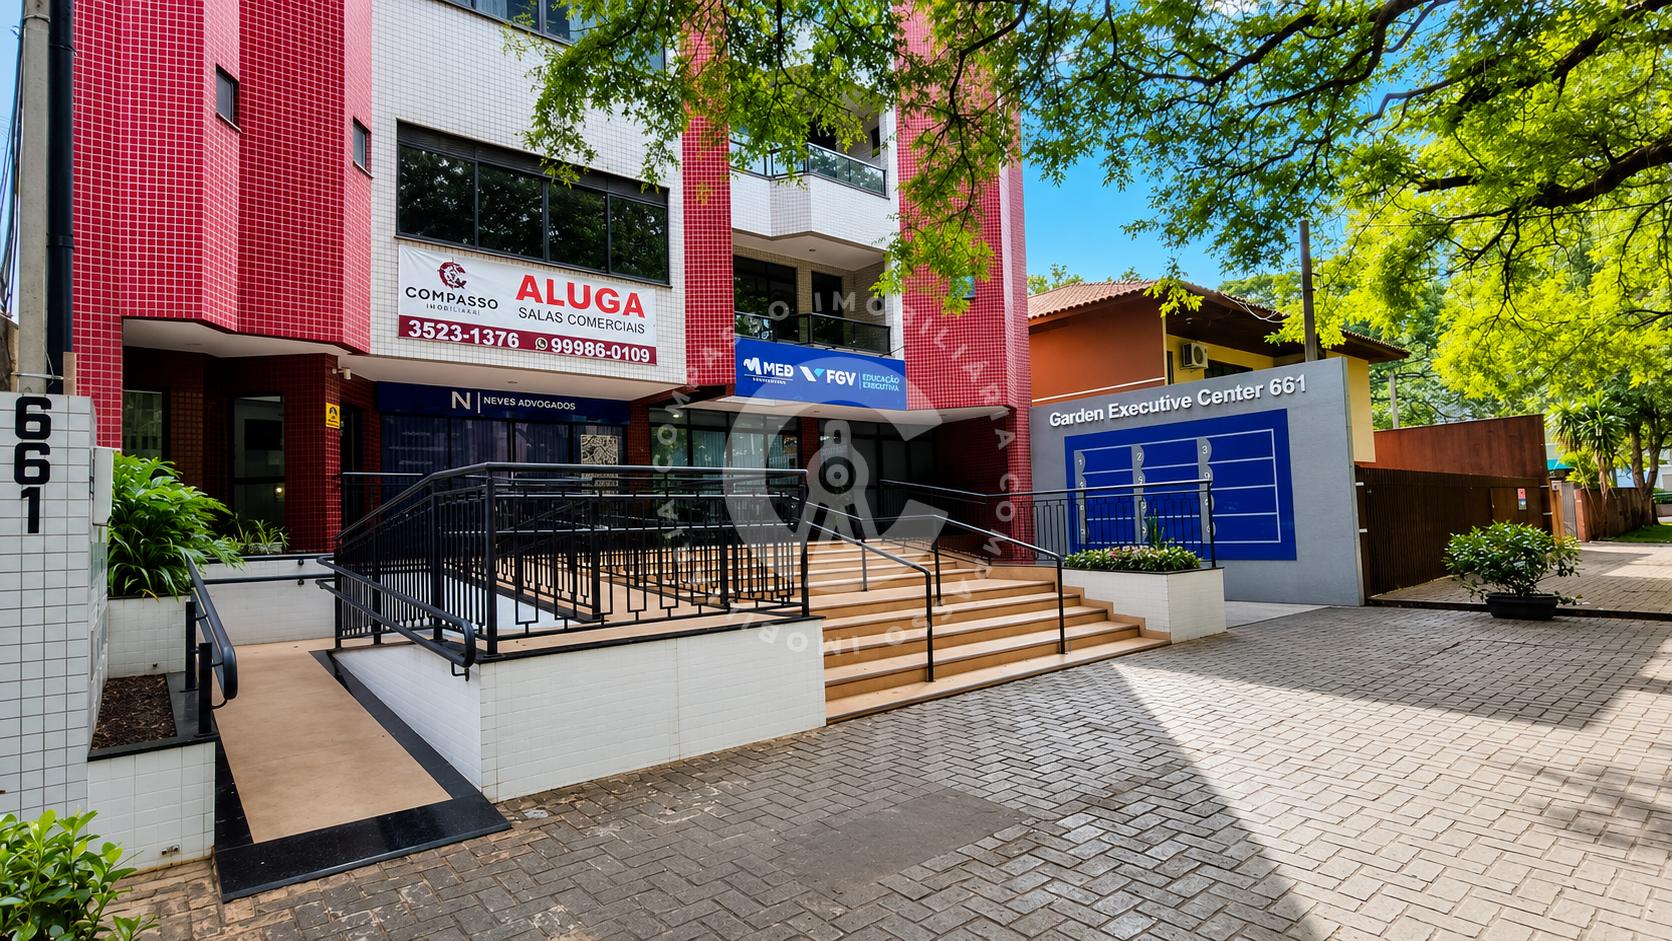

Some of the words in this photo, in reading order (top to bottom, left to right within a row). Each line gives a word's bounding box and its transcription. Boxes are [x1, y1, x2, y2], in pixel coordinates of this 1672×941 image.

[405, 286, 499, 310] COMPASSO
[516, 274, 645, 318] ALUGA
[408, 319, 519, 348] 3523-1376
[518, 307, 563, 323] SALAS
[567, 313, 645, 334] COMERCIAIS
[550, 337, 650, 362] 99986-0109
[826, 369, 857, 387] FGV
[862, 373, 900, 385] EDUCAÇÃO
[451, 391, 471, 410] N
[483, 396, 516, 406] NEVES
[518, 399, 576, 411] ADVOGADOS
[1049, 408, 1105, 428] Garden
[1108, 394, 1193, 420] Executive
[1197, 382, 1265, 407] Center
[1269, 374, 1307, 396] 661
[14, 396, 52, 534] 661
